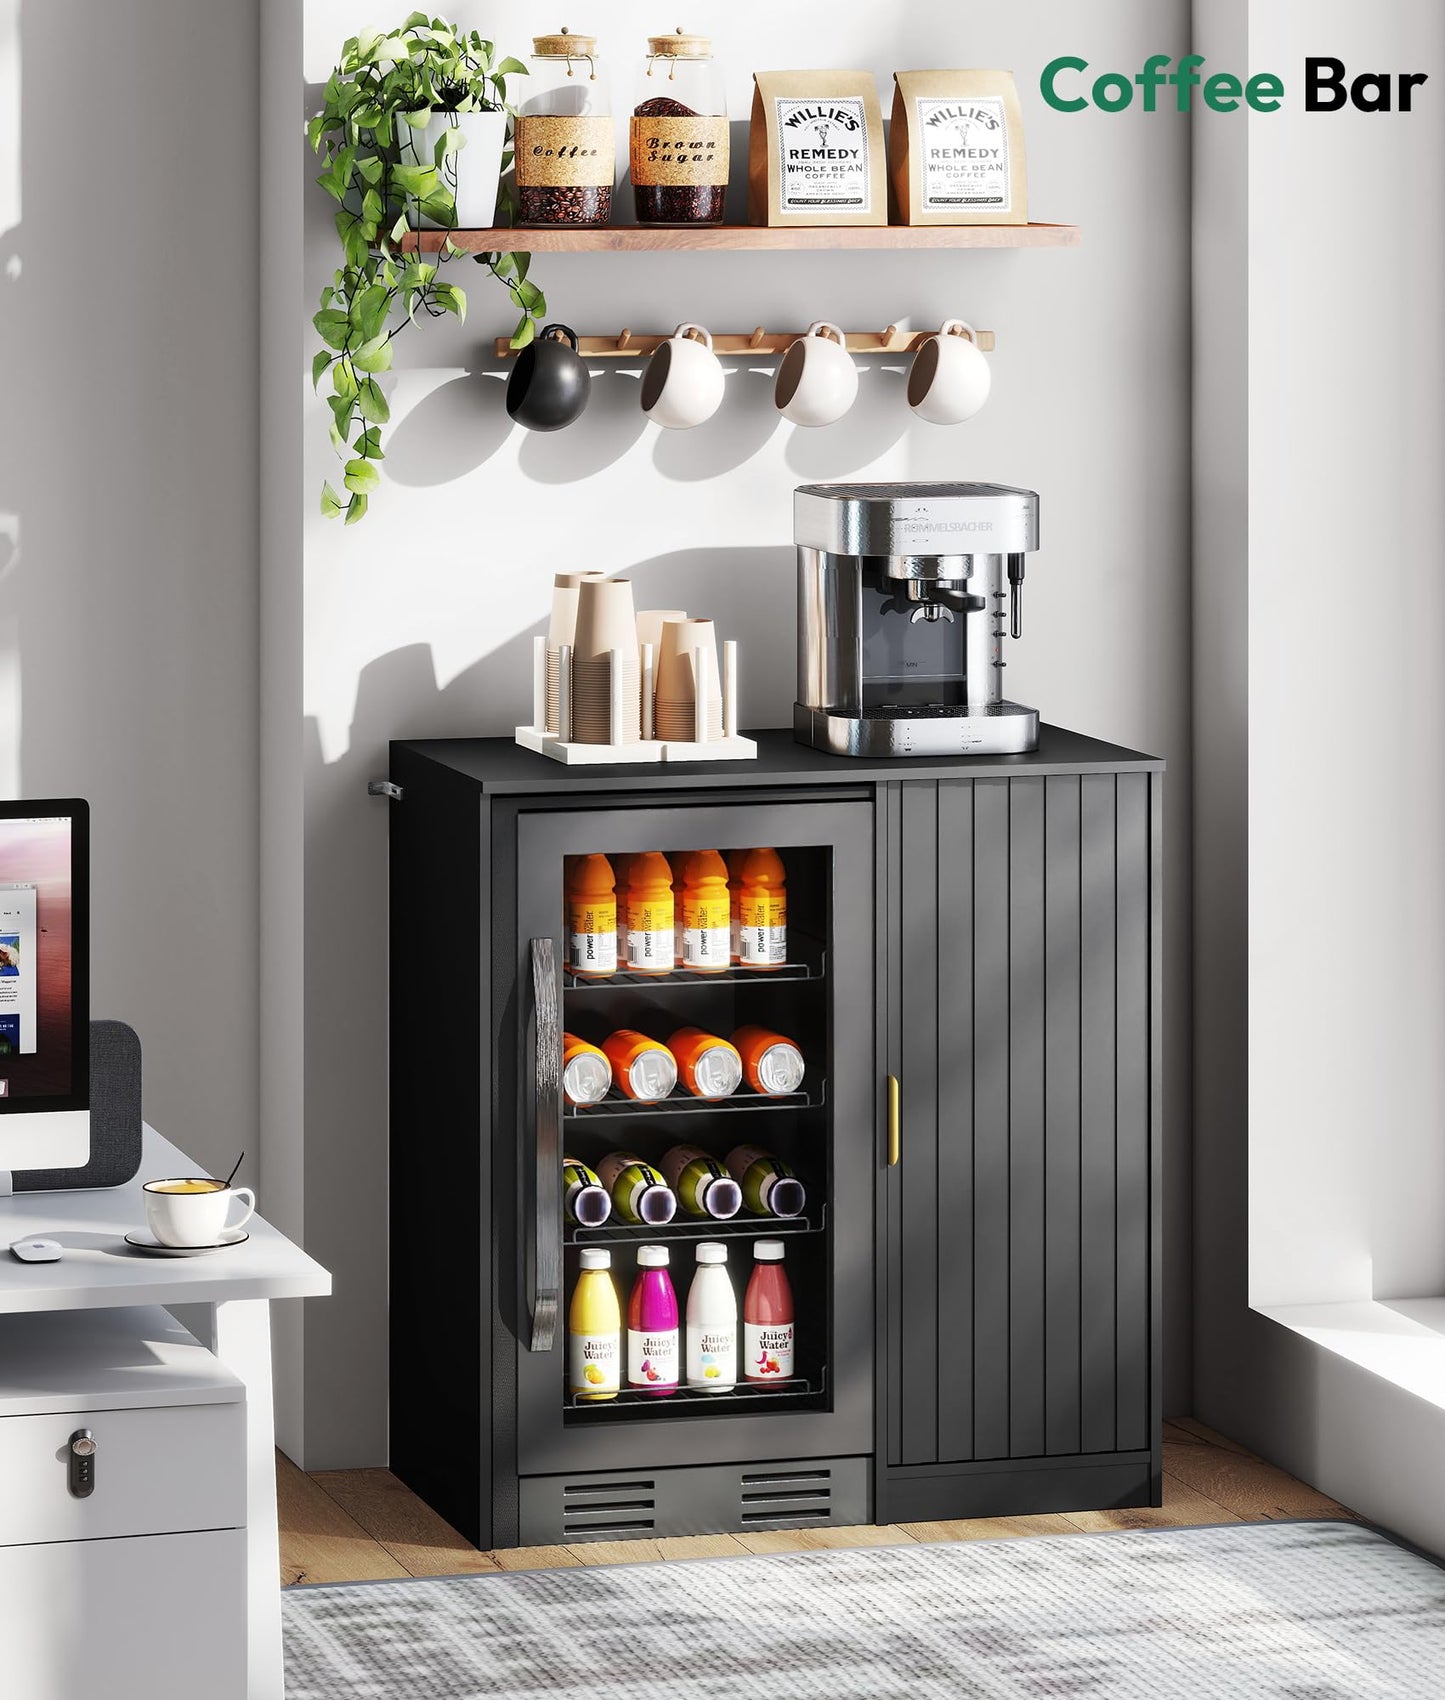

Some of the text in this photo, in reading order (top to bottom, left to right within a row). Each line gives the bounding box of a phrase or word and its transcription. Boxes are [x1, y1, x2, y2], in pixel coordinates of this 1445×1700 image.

[785, 106, 860, 132] WILLIE'S
[925, 105, 1000, 130] WILLIE'S
[646, 137, 716, 149] Brown
[533, 145, 597, 158] Coffee
[789, 148, 859, 160] REMEDY
[930, 148, 999, 159] REMEDY
[647, 150, 714, 164] Sugar
[786, 163, 863, 173] WHOLE BEAN
[927, 162, 1003, 172] WHOLE BEAN
[904, 521, 993, 533] ROMMELSBACHER
[702, 1335, 729, 1345] Juicy
[760, 1331, 788, 1342] Juicy
[584, 1342, 613, 1352] Juicy
[643, 1338, 671, 1348] Juicy
[701, 1343, 731, 1353] Water
[759, 1340, 789, 1350] Water
[583, 1350, 614, 1360] Water
[643, 1347, 672, 1356] Water
